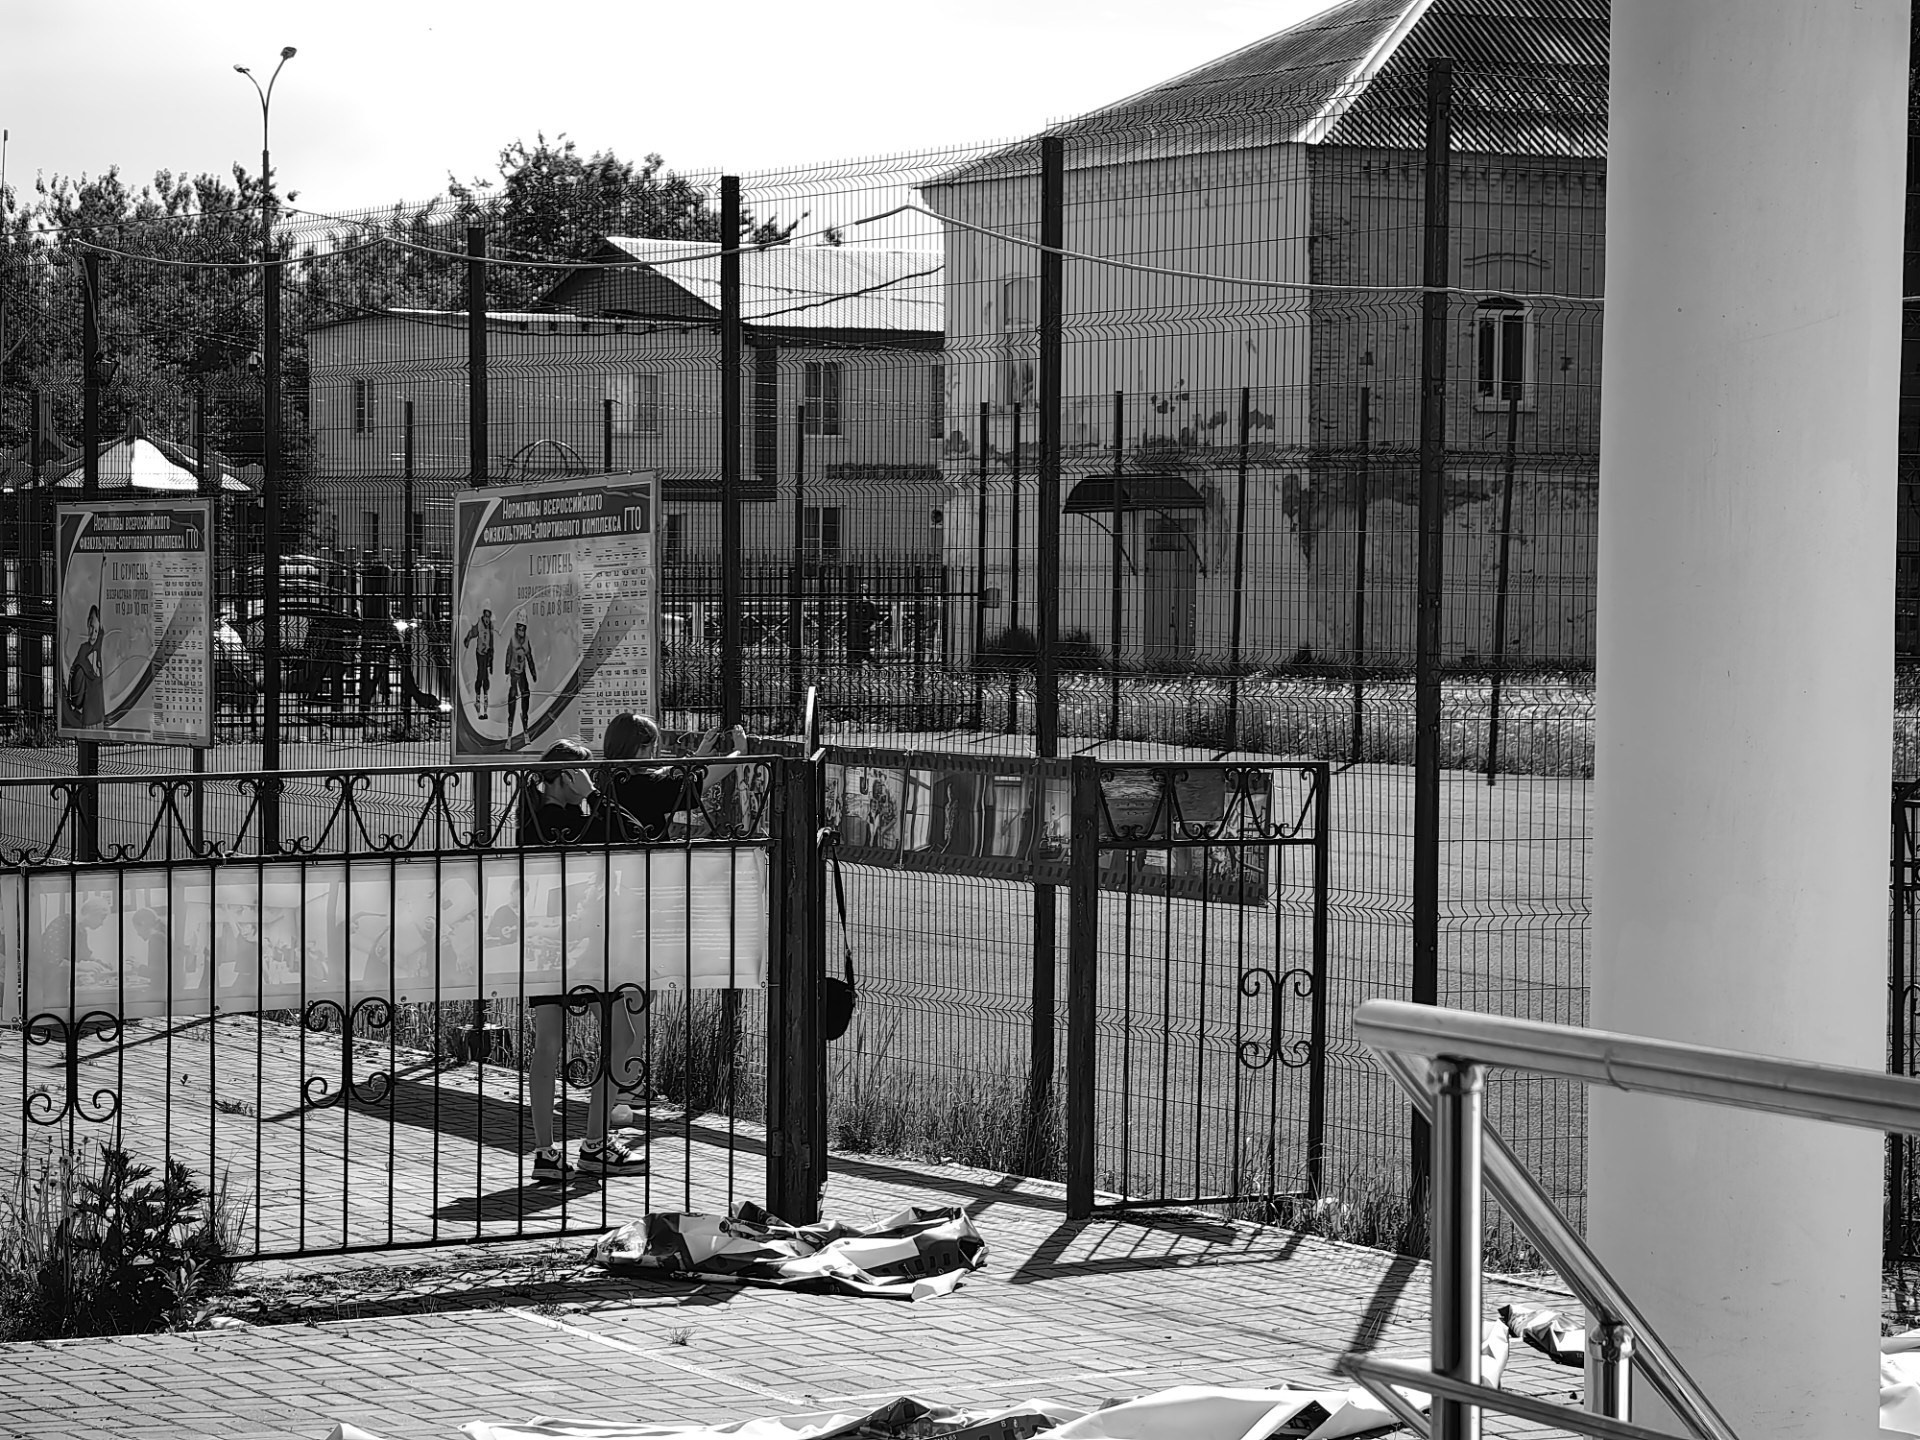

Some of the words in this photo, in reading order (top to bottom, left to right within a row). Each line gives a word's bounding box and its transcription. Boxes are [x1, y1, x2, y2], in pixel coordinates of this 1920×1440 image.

[581, 515, 622, 535] КОМПЛЕКСА
[624, 506, 642, 532] ГТО
[186, 528, 199, 549] ГТО
[120, 562, 149, 581] СТУПЕНЬ
[536, 553, 573, 575] СТУПЕНЬ
[546, 601, 556, 617] ДО
